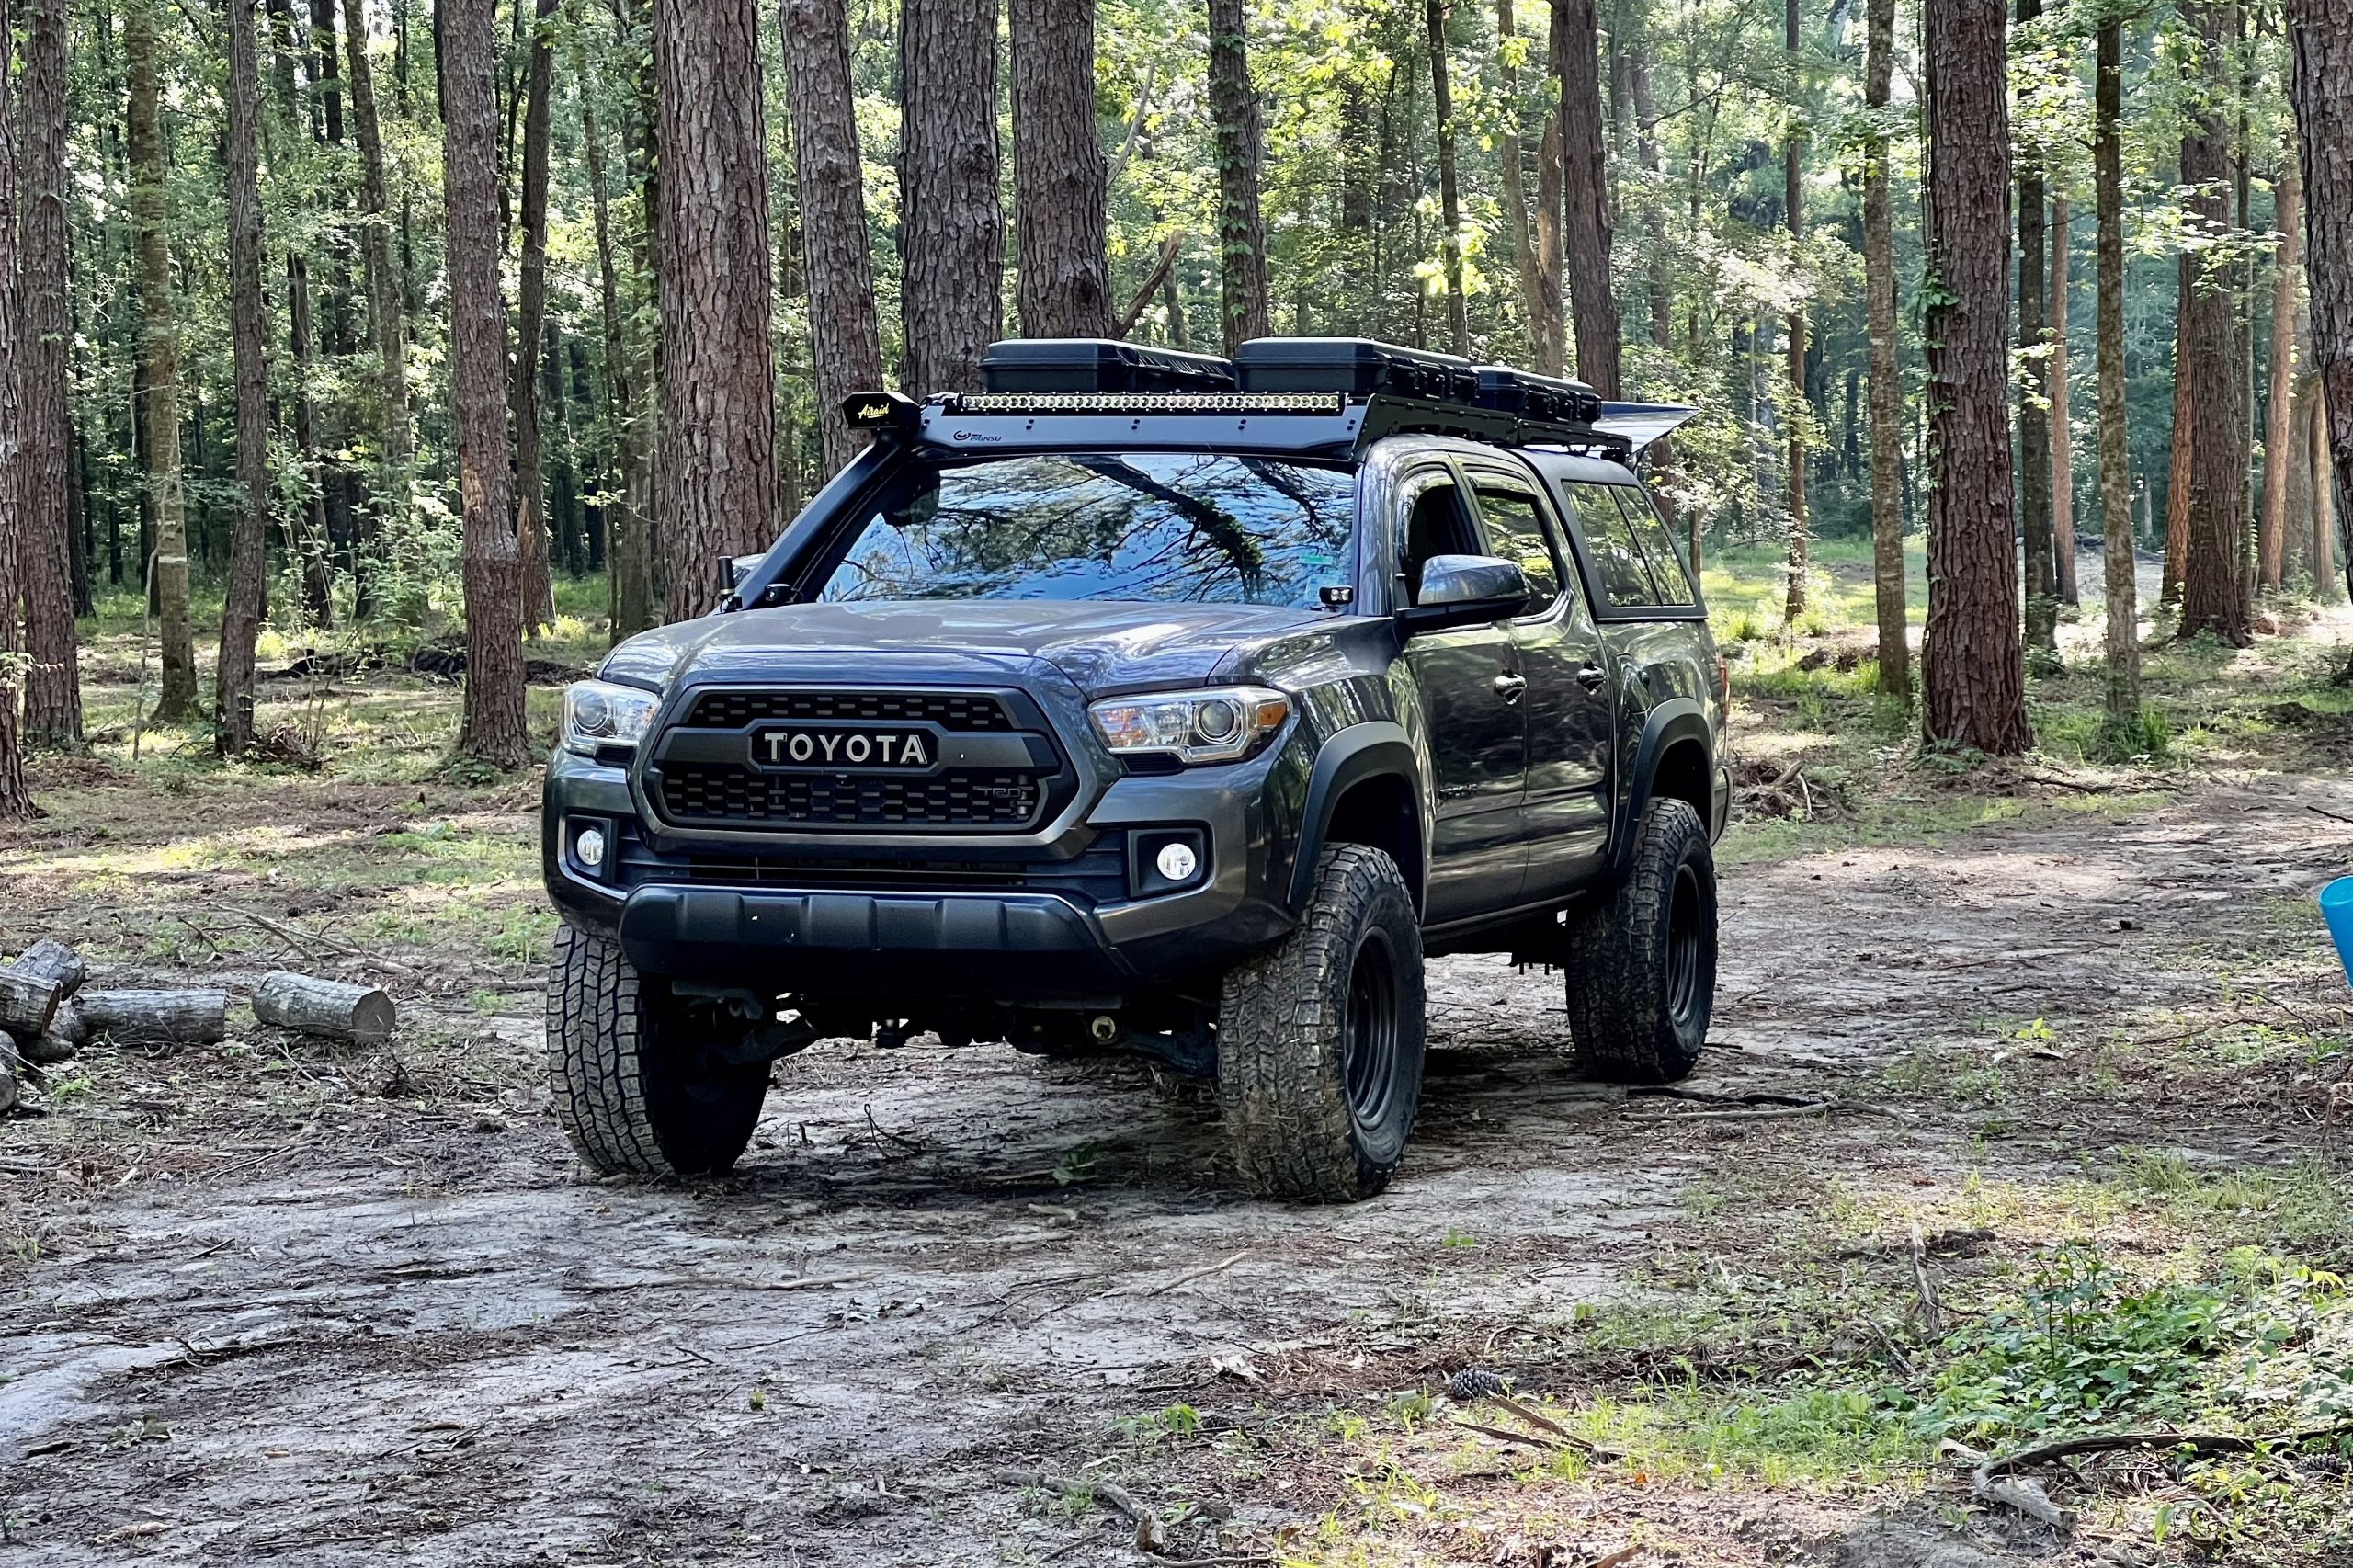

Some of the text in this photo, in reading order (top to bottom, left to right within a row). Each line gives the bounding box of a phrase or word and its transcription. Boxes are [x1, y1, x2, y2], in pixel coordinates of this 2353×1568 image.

[858, 403, 890, 419] Airaid
[765, 733, 928, 765] TOYOTA
[976, 787, 1021, 798] TRD
